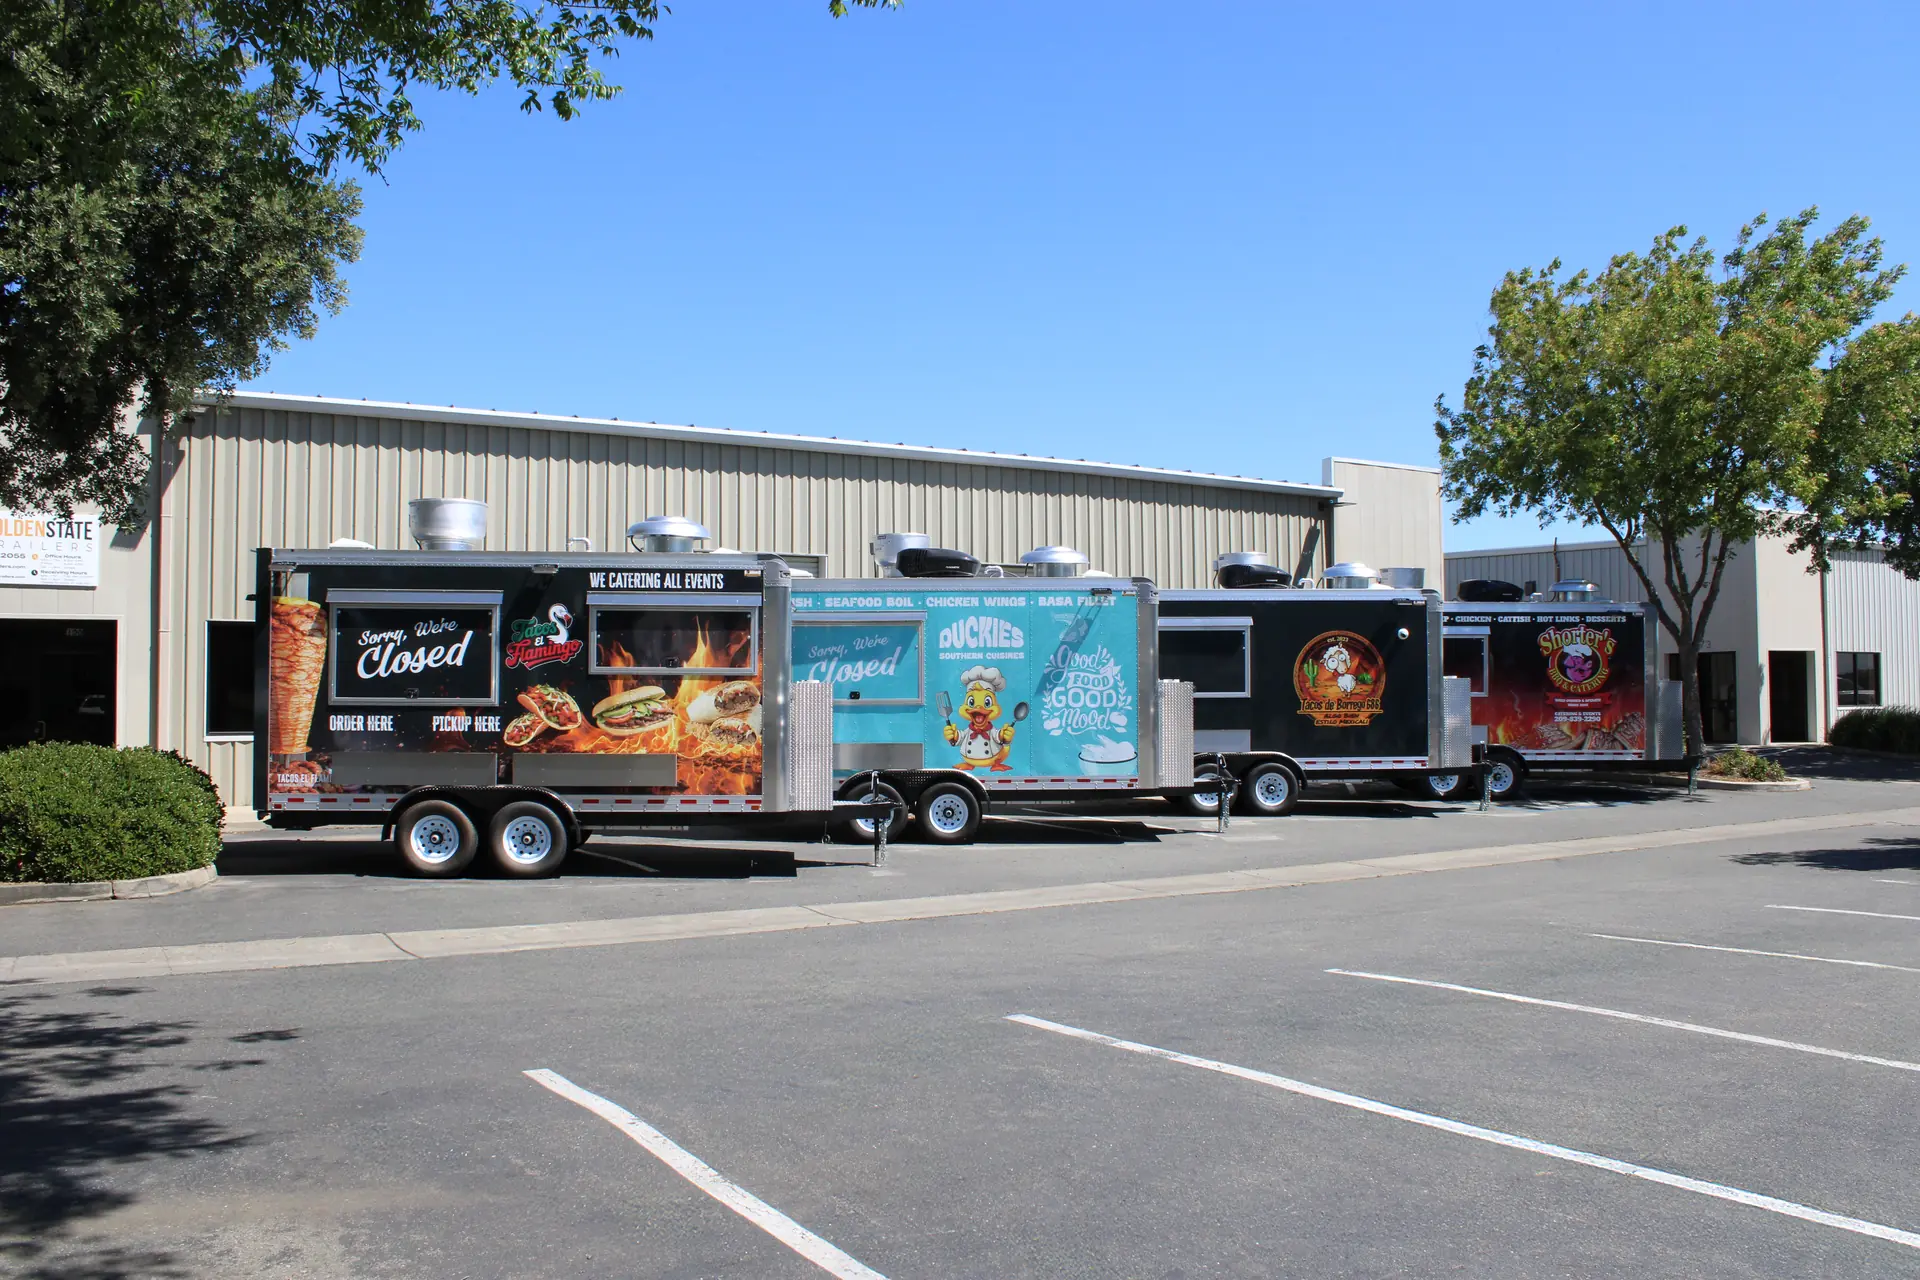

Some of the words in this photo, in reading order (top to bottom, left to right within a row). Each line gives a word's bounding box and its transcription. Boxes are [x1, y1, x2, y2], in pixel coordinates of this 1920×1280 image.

[590, 572, 605, 589] WE
[609, 572, 660, 589] CATERING
[664, 573, 682, 589] ALL
[685, 573, 724, 589] EVENTS
[825, 597, 882, 607] SEAFOOD
[886, 597, 914, 607] BOIL
[926, 597, 979, 607] CHICKEN
[983, 596, 1026, 607] WINGS
[1038, 596, 1074, 607] BASA
[358, 630, 408, 647] Sorry,
[414, 617, 458, 637] We're
[512, 618, 558, 642] Tacos
[939, 616, 1025, 649] DUCKIES
[1539, 626, 1616, 655] Shorter's
[534, 636, 545, 646] El
[808, 644, 848, 659] Sorry,
[853, 634, 889, 650] We're
[357, 630, 473, 679] Closed
[505, 639, 582, 666] Flamingo
[939, 652, 983, 660] SOUTHERN
[986, 652, 1025, 660] CUISINES
[808, 646, 902, 684] Closed
[1073, 674, 1110, 687] FOOD
[1548, 668, 1564, 686] BBQ
[1570, 667, 1609, 693] CATERING
[1051, 687, 1117, 708] GOOD
[1301, 698, 1323, 710] Tacos
[1325, 698, 1334, 710] de
[1336, 698, 1365, 711] Borrego
[329, 715, 364, 732] ORDER
[367, 715, 394, 732] HERE
[433, 715, 472, 732] PICKUP
[475, 715, 501, 732] HERE
[277, 773, 299, 783] TACOS
[301, 773, 309, 783] EL
